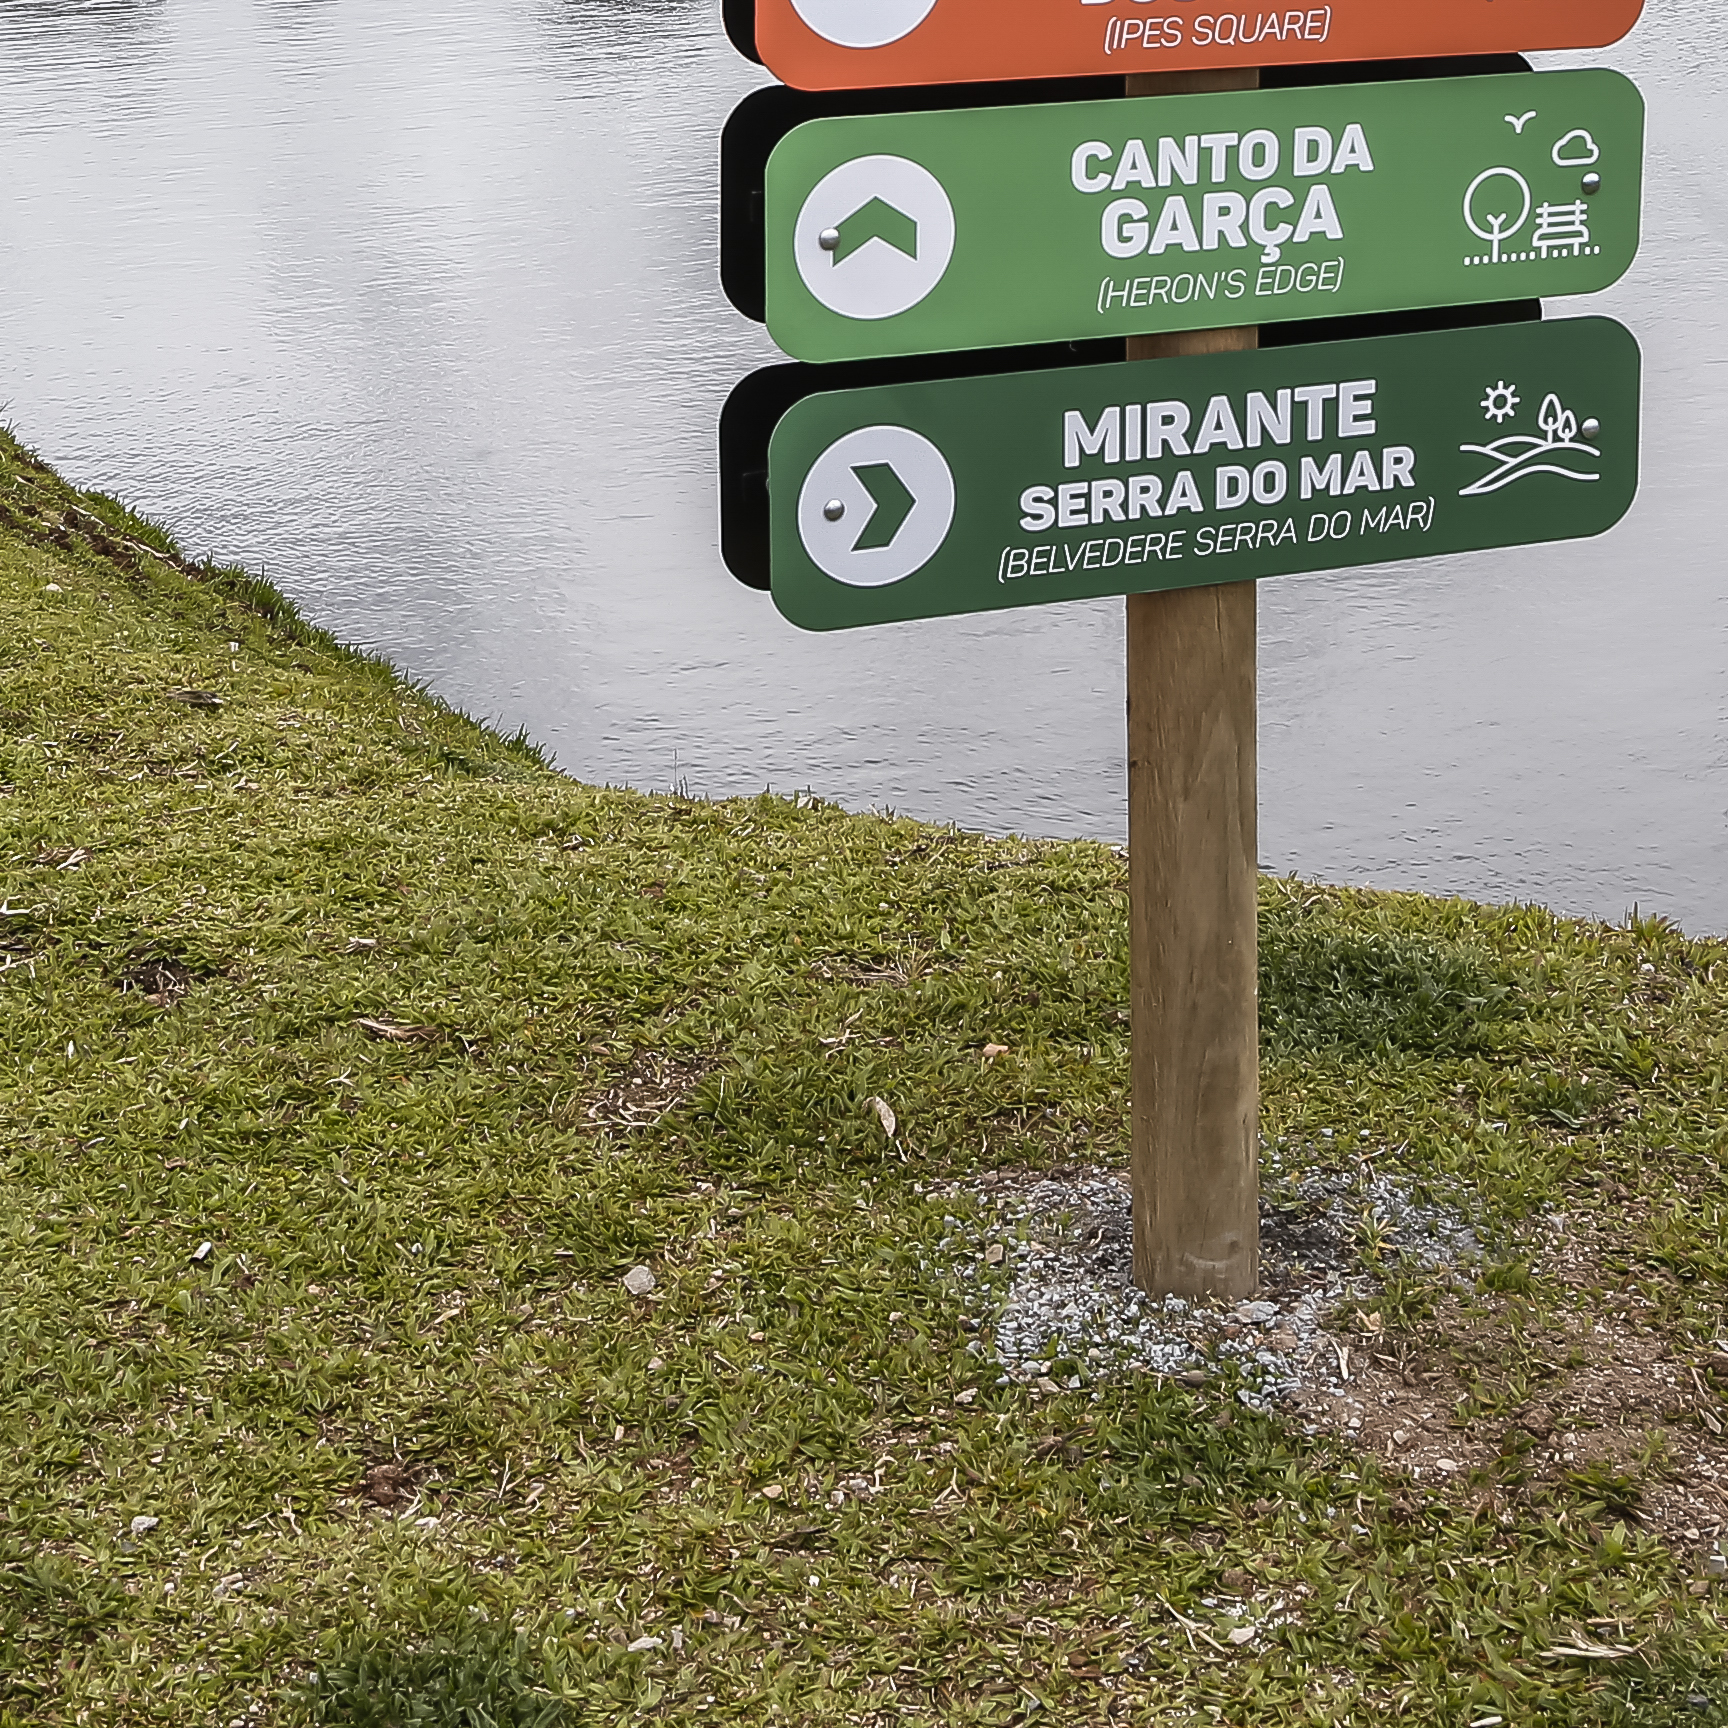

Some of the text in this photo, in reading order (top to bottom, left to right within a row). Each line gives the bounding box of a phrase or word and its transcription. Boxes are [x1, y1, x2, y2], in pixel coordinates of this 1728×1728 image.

[1104, 5, 1331, 55] (IPES SQUARE)
[1071, 123, 1375, 193] CANTO DA
[1101, 184, 1344, 264] GARÇA
[1097, 256, 1345, 314] (HERON'S EDGE)
[1064, 379, 1377, 468] MIRANTE
[1019, 446, 1416, 531] SERRA DO MAR
[998, 496, 1435, 584] (BELVEDERE SERRA DO MAR)
